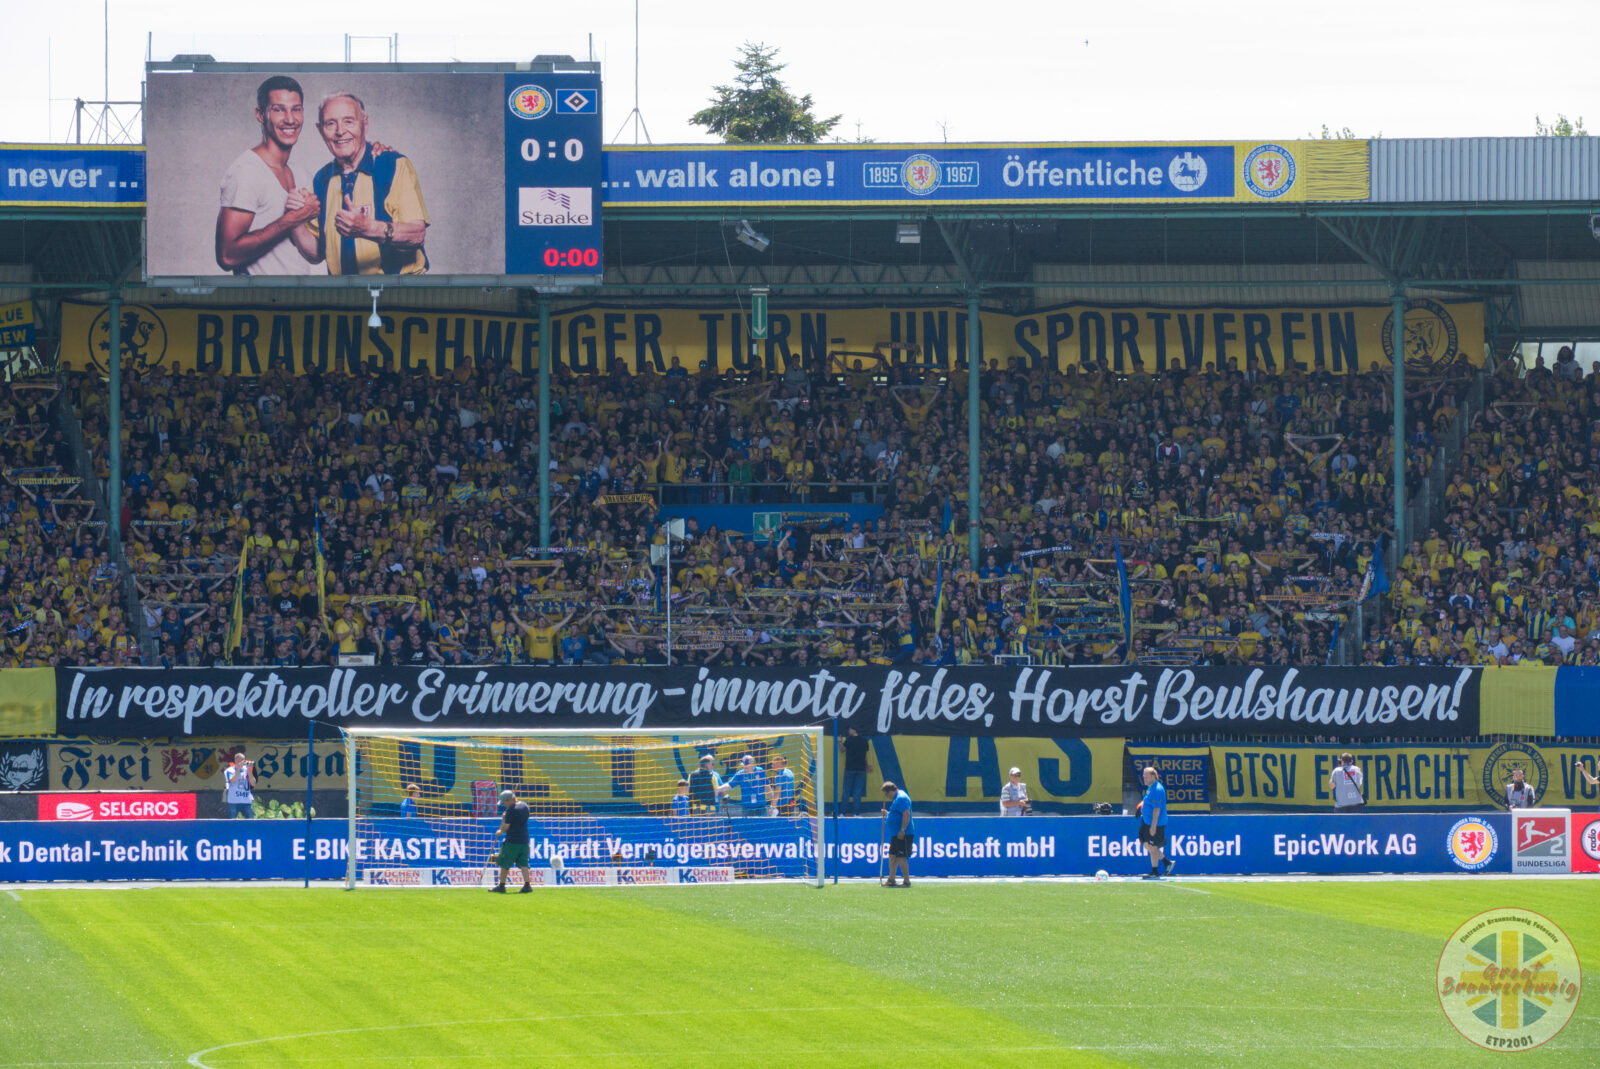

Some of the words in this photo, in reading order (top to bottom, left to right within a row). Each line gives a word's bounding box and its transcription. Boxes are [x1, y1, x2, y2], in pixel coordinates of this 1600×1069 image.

[729, 160, 835, 188] alone!
[868, 166, 898, 184] 1895
[945, 166, 974, 183] 1967
[1002, 154, 1163, 188] Öffentliche
[521, 210, 590, 226] Staake
[543, 248, 598, 268] 0:00
[199, 308, 665, 377] BRAUNSCHWEIGER
[700, 312, 846, 373] TURN-
[889, 311, 983, 373] UND
[1014, 311, 1359, 374] SPORTVEREIN
[66, 672, 114, 720] In
[118, 668, 408, 735] respektvoller
[411, 667, 659, 729] Erinnerung
[690, 666, 866, 719] immota
[877, 667, 995, 734] fides,
[1009, 667, 1148, 725] Horst
[1153, 667, 1473, 725] Beulshausen!
[1133, 757, 1203, 771] STÄRKER
[1225, 752, 1297, 798] BTSV
[1166, 774, 1204, 786] EURE
[100, 801, 179, 817] SELGROS
[18, 839, 189, 863] Dental-Technik
[196, 838, 262, 862] GmbH
[374, 837, 466, 860] KASTEN
[1006, 836, 1056, 858] mbH
[1170, 834, 1241, 857] Köberl
[1274, 834, 1382, 860] EpicWork
[1384, 833, 1417, 855] AG
[1550, 837, 1563, 854] 2
[1587, 828, 1597, 852] radio
[1516, 859, 1567, 868] BUNDESLIGA
